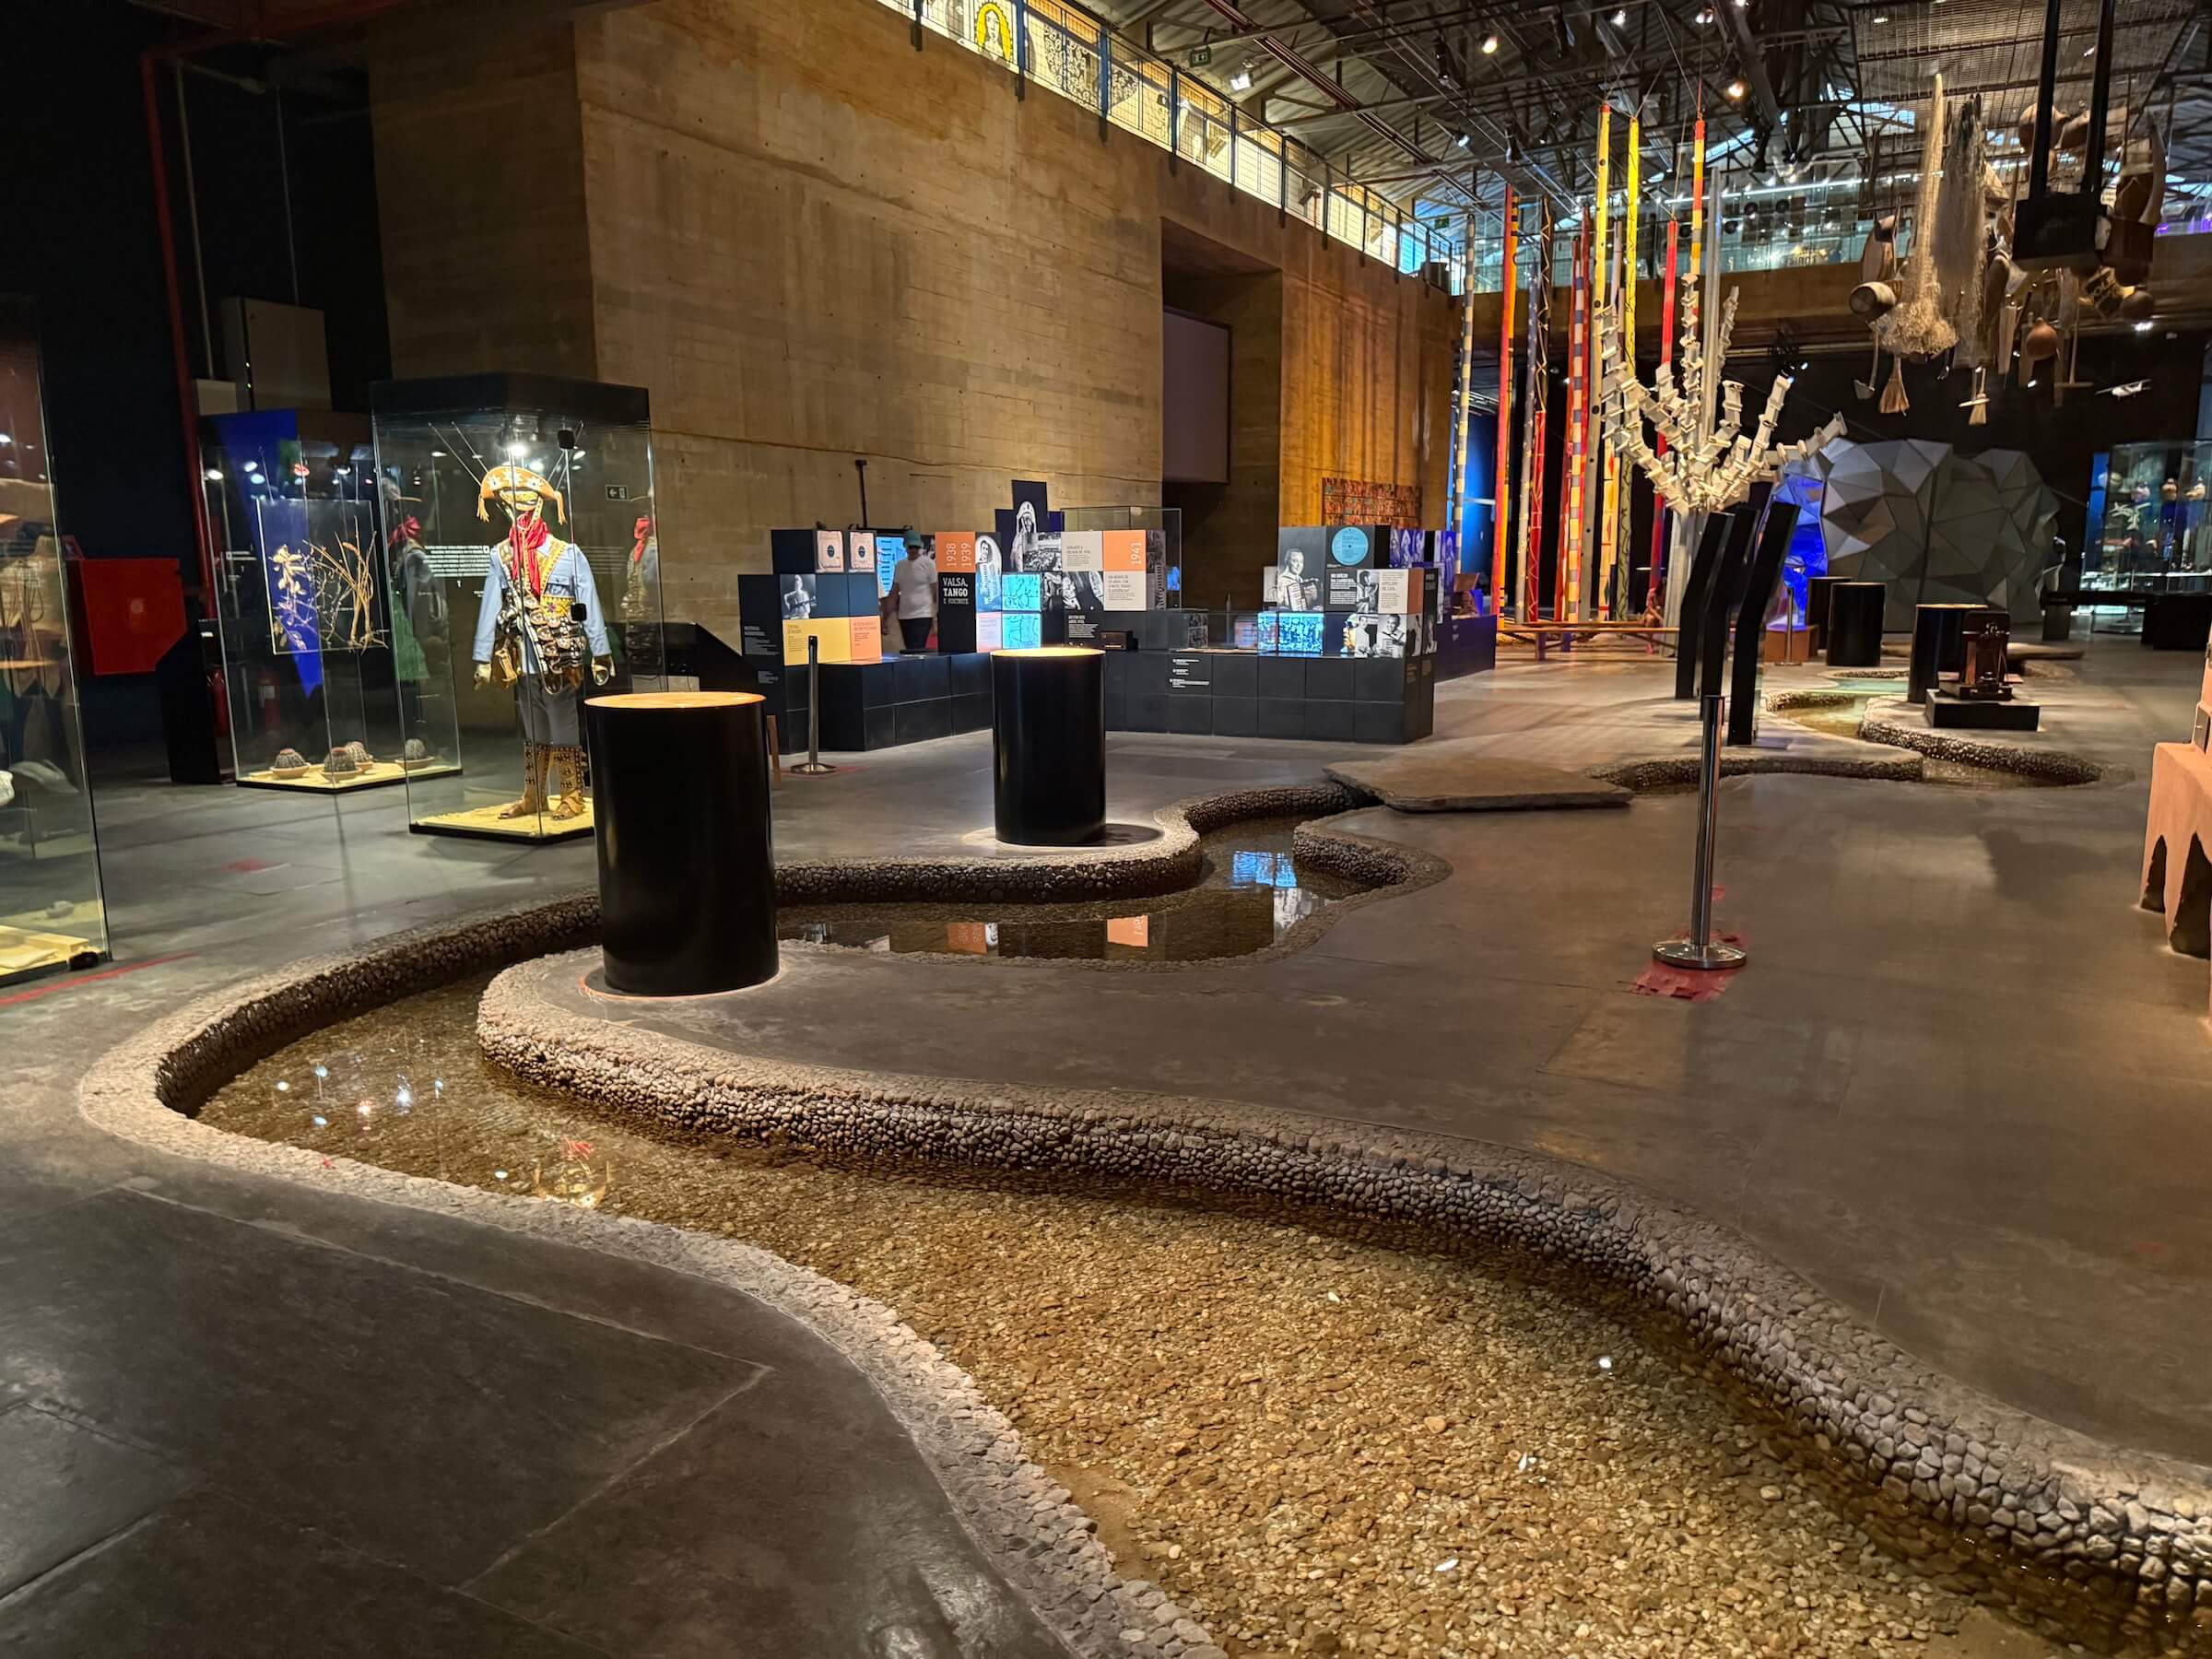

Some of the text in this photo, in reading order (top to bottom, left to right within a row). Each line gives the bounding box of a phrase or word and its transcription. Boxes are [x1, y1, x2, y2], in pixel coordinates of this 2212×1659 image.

[946, 542, 958, 567] 1938
[960, 542, 972, 567] 1939
[1130, 542, 1143, 564] 1941
[942, 577, 969, 588] VALSA,
[943, 588, 969, 597] TANGO
